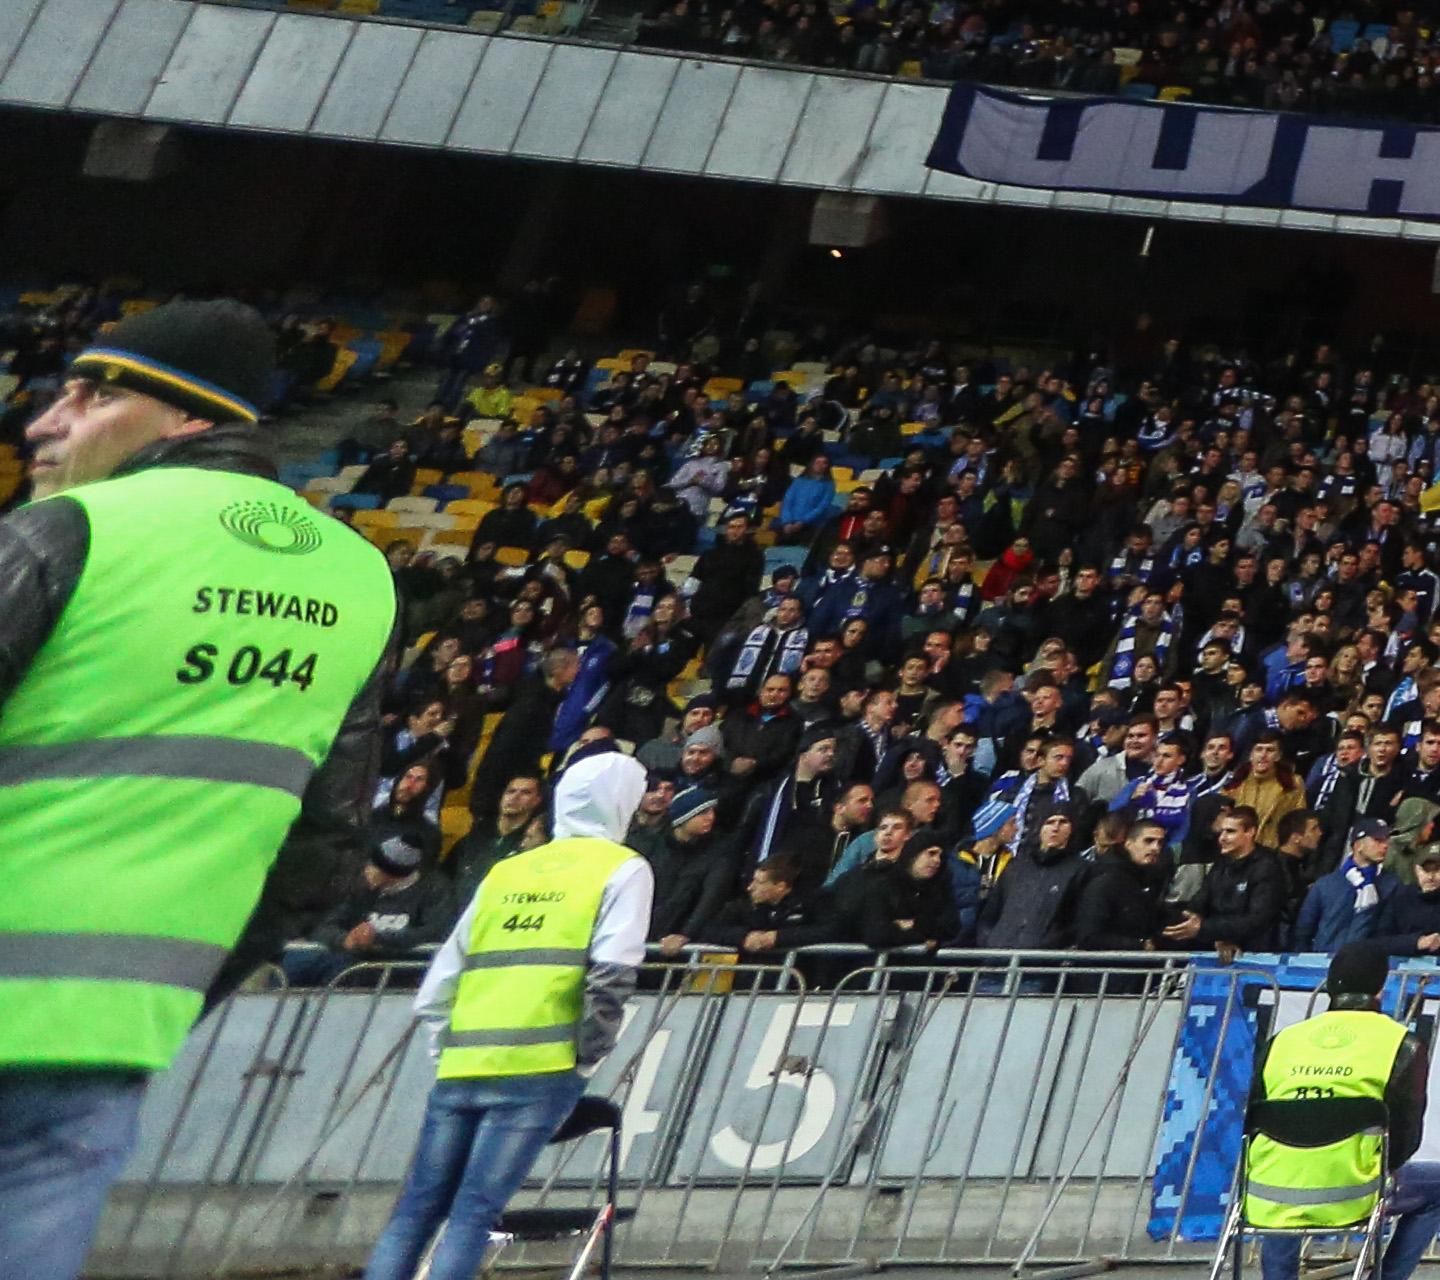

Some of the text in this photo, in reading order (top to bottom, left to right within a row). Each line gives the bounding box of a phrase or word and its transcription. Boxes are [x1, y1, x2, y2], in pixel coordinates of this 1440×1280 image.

[192, 586, 338, 627] STEWARD
[176, 642, 318, 691] S 044
[501, 891, 566, 905] STEWARD
[502, 913, 546, 933] 444
[1290, 1066, 1353, 1077] STEWARD
